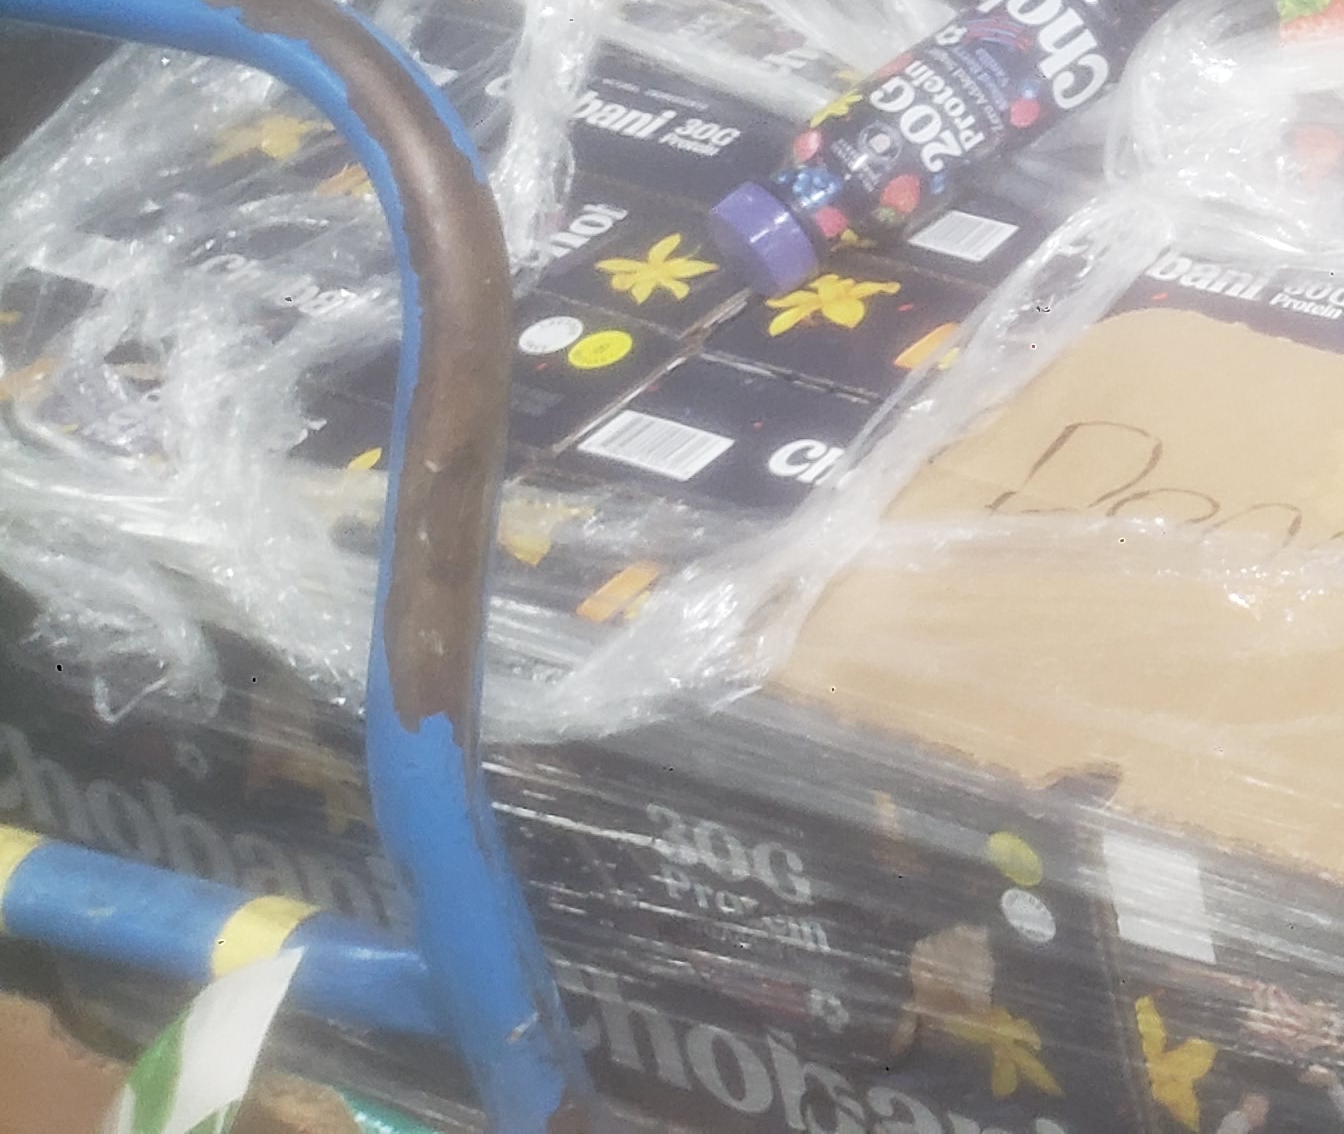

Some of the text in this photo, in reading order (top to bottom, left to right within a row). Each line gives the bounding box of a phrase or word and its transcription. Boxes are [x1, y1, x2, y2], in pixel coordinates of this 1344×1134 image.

[674, 117, 743, 147] 30G
[868, 75, 964, 174] 20G
[904, 59, 987, 153] Protein
[1269, 292, 1344, 320] Protein
[645, 802, 813, 906] 30G
